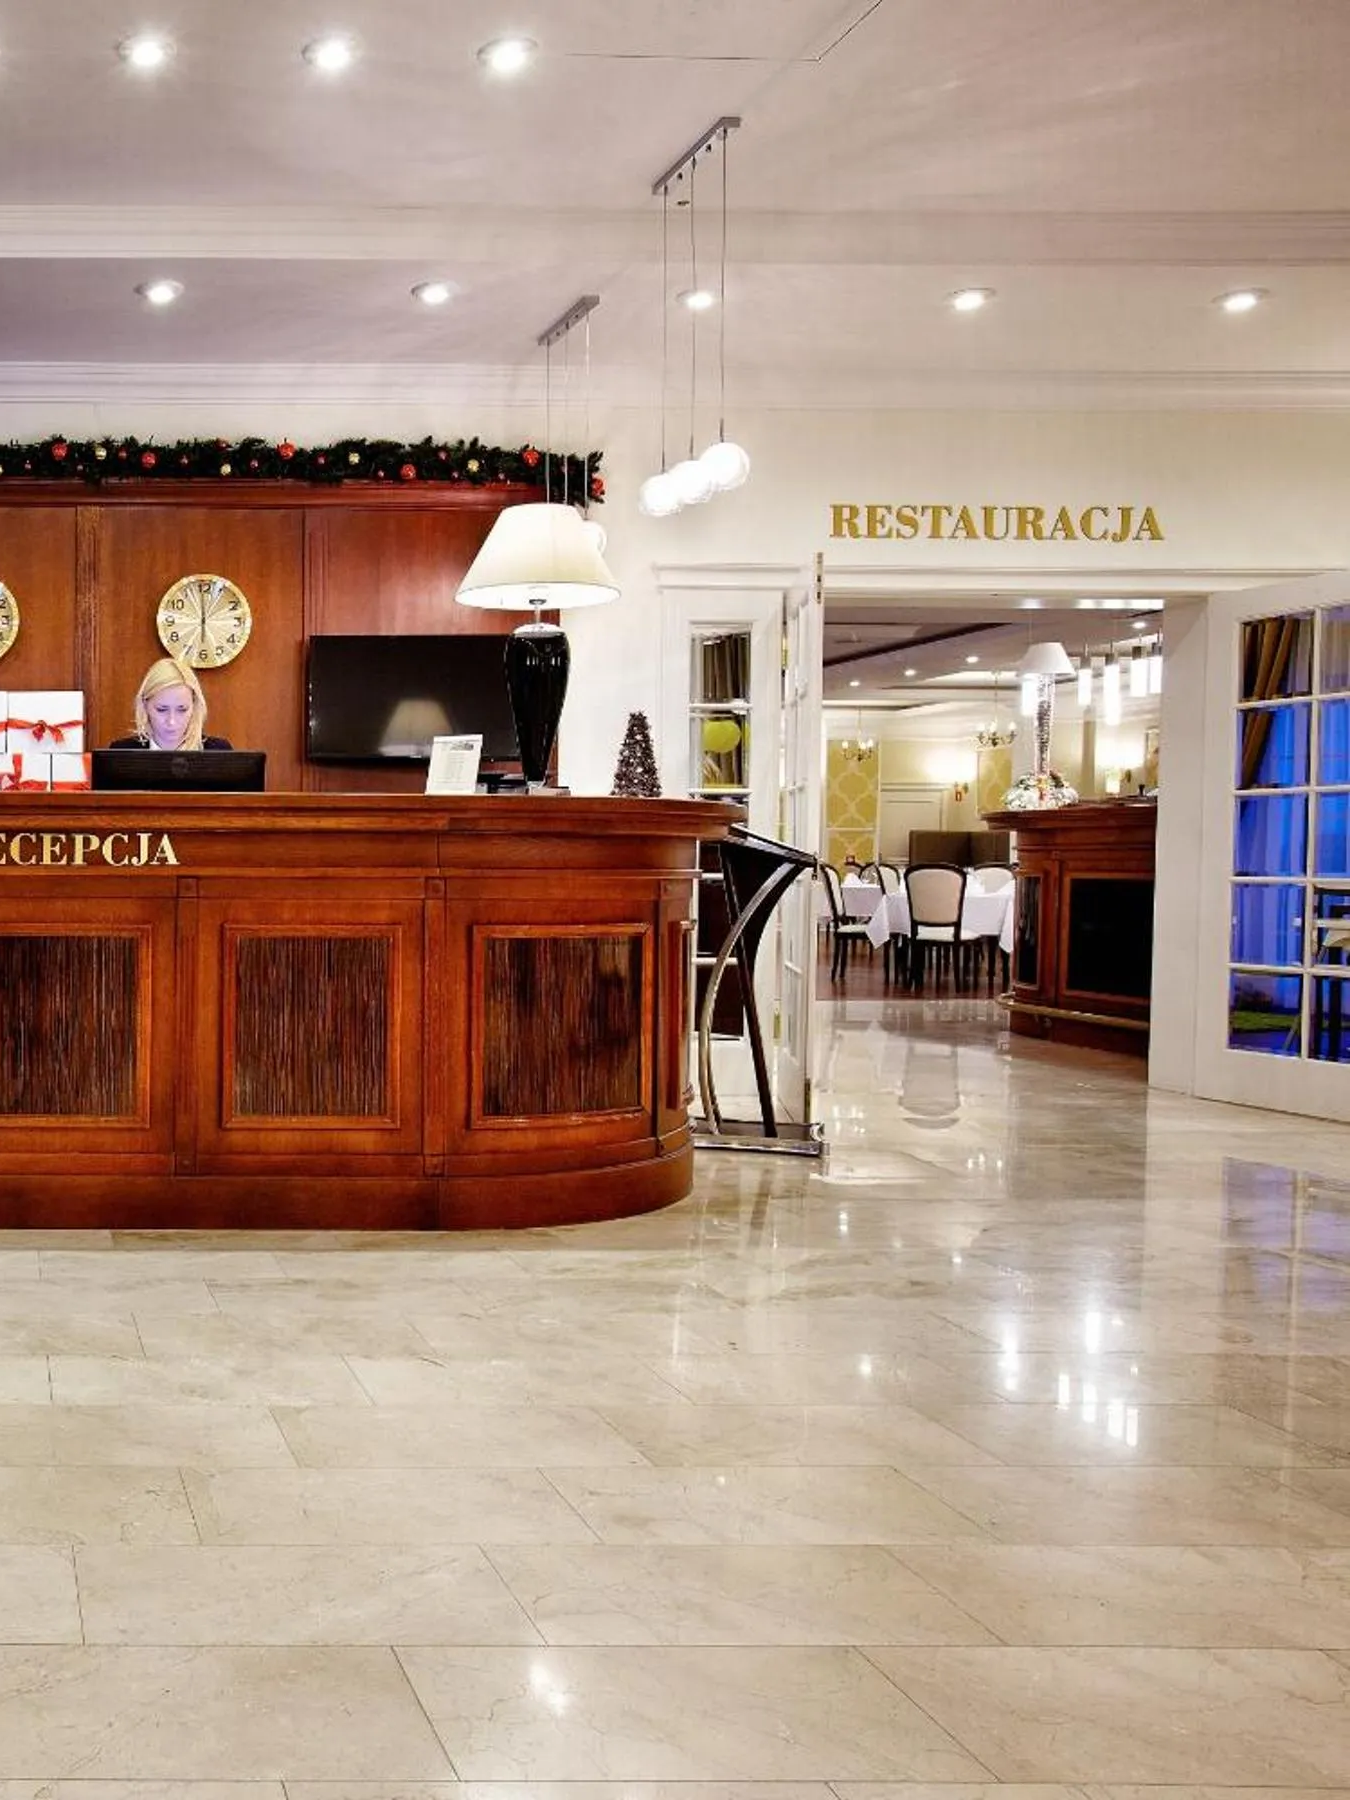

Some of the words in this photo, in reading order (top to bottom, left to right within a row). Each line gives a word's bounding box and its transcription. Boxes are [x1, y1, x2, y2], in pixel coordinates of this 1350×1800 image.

[829, 504, 1165, 543] RESTAURACJA
[198, 583, 211, 593] 12
[171, 599, 184, 610] 10
[229, 600, 239, 611] 2
[1, 615, 10, 625] 3
[165, 615, 175, 627] 9
[234, 617, 242, 627] 3
[171, 631, 179, 642] 8
[226, 634, 235, 644] 4
[199, 649, 208, 660] 6
[215, 646, 224, 656] 5
